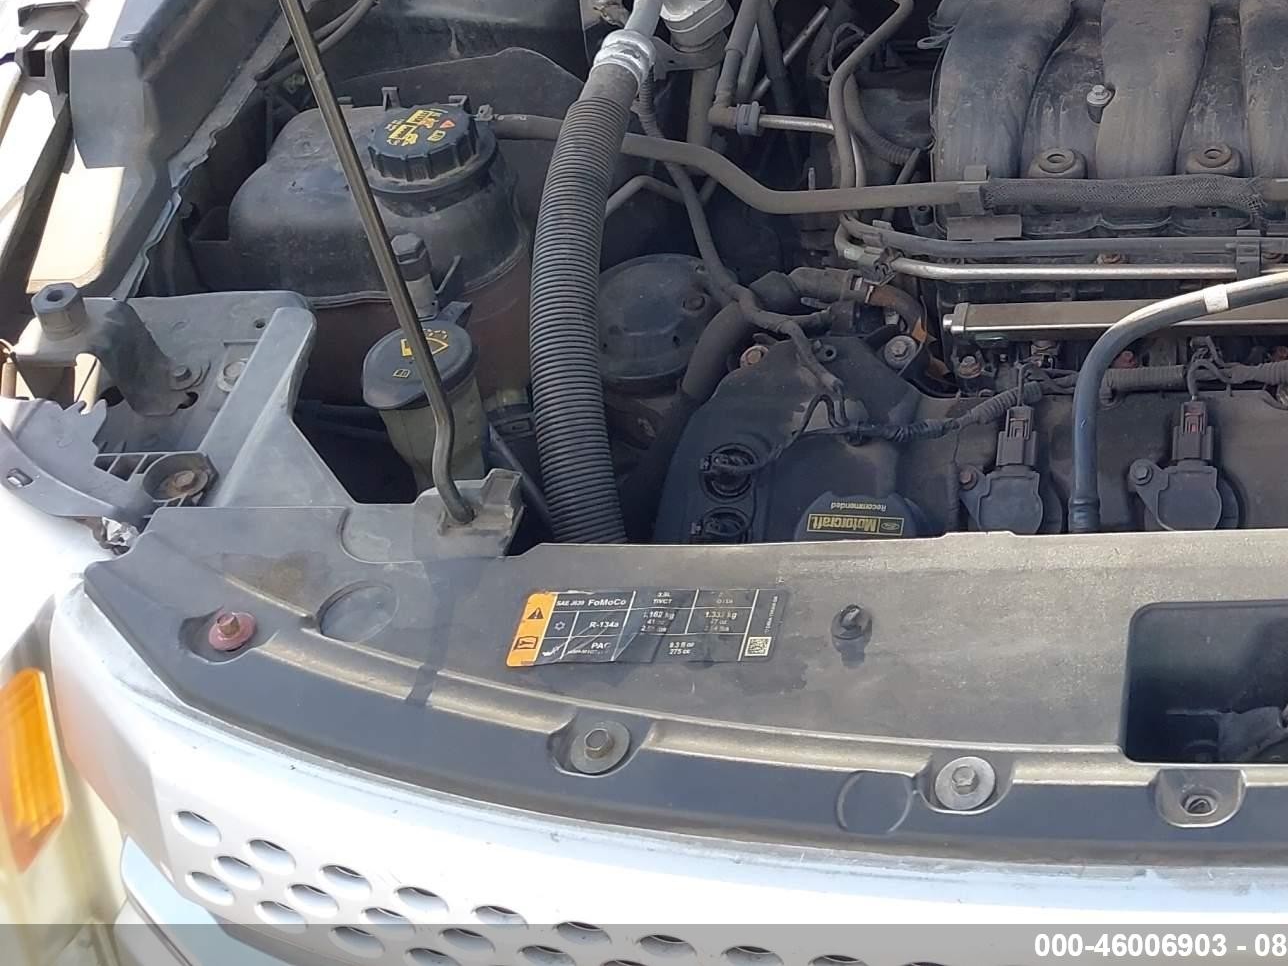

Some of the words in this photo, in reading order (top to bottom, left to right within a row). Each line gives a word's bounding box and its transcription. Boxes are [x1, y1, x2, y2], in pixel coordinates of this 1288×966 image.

[830, 501, 888, 513] Recommended
[811, 516, 878, 533] Motorcraft
[587, 598, 627, 607] FoMoCo
[588, 621, 620, 629] R-134a
